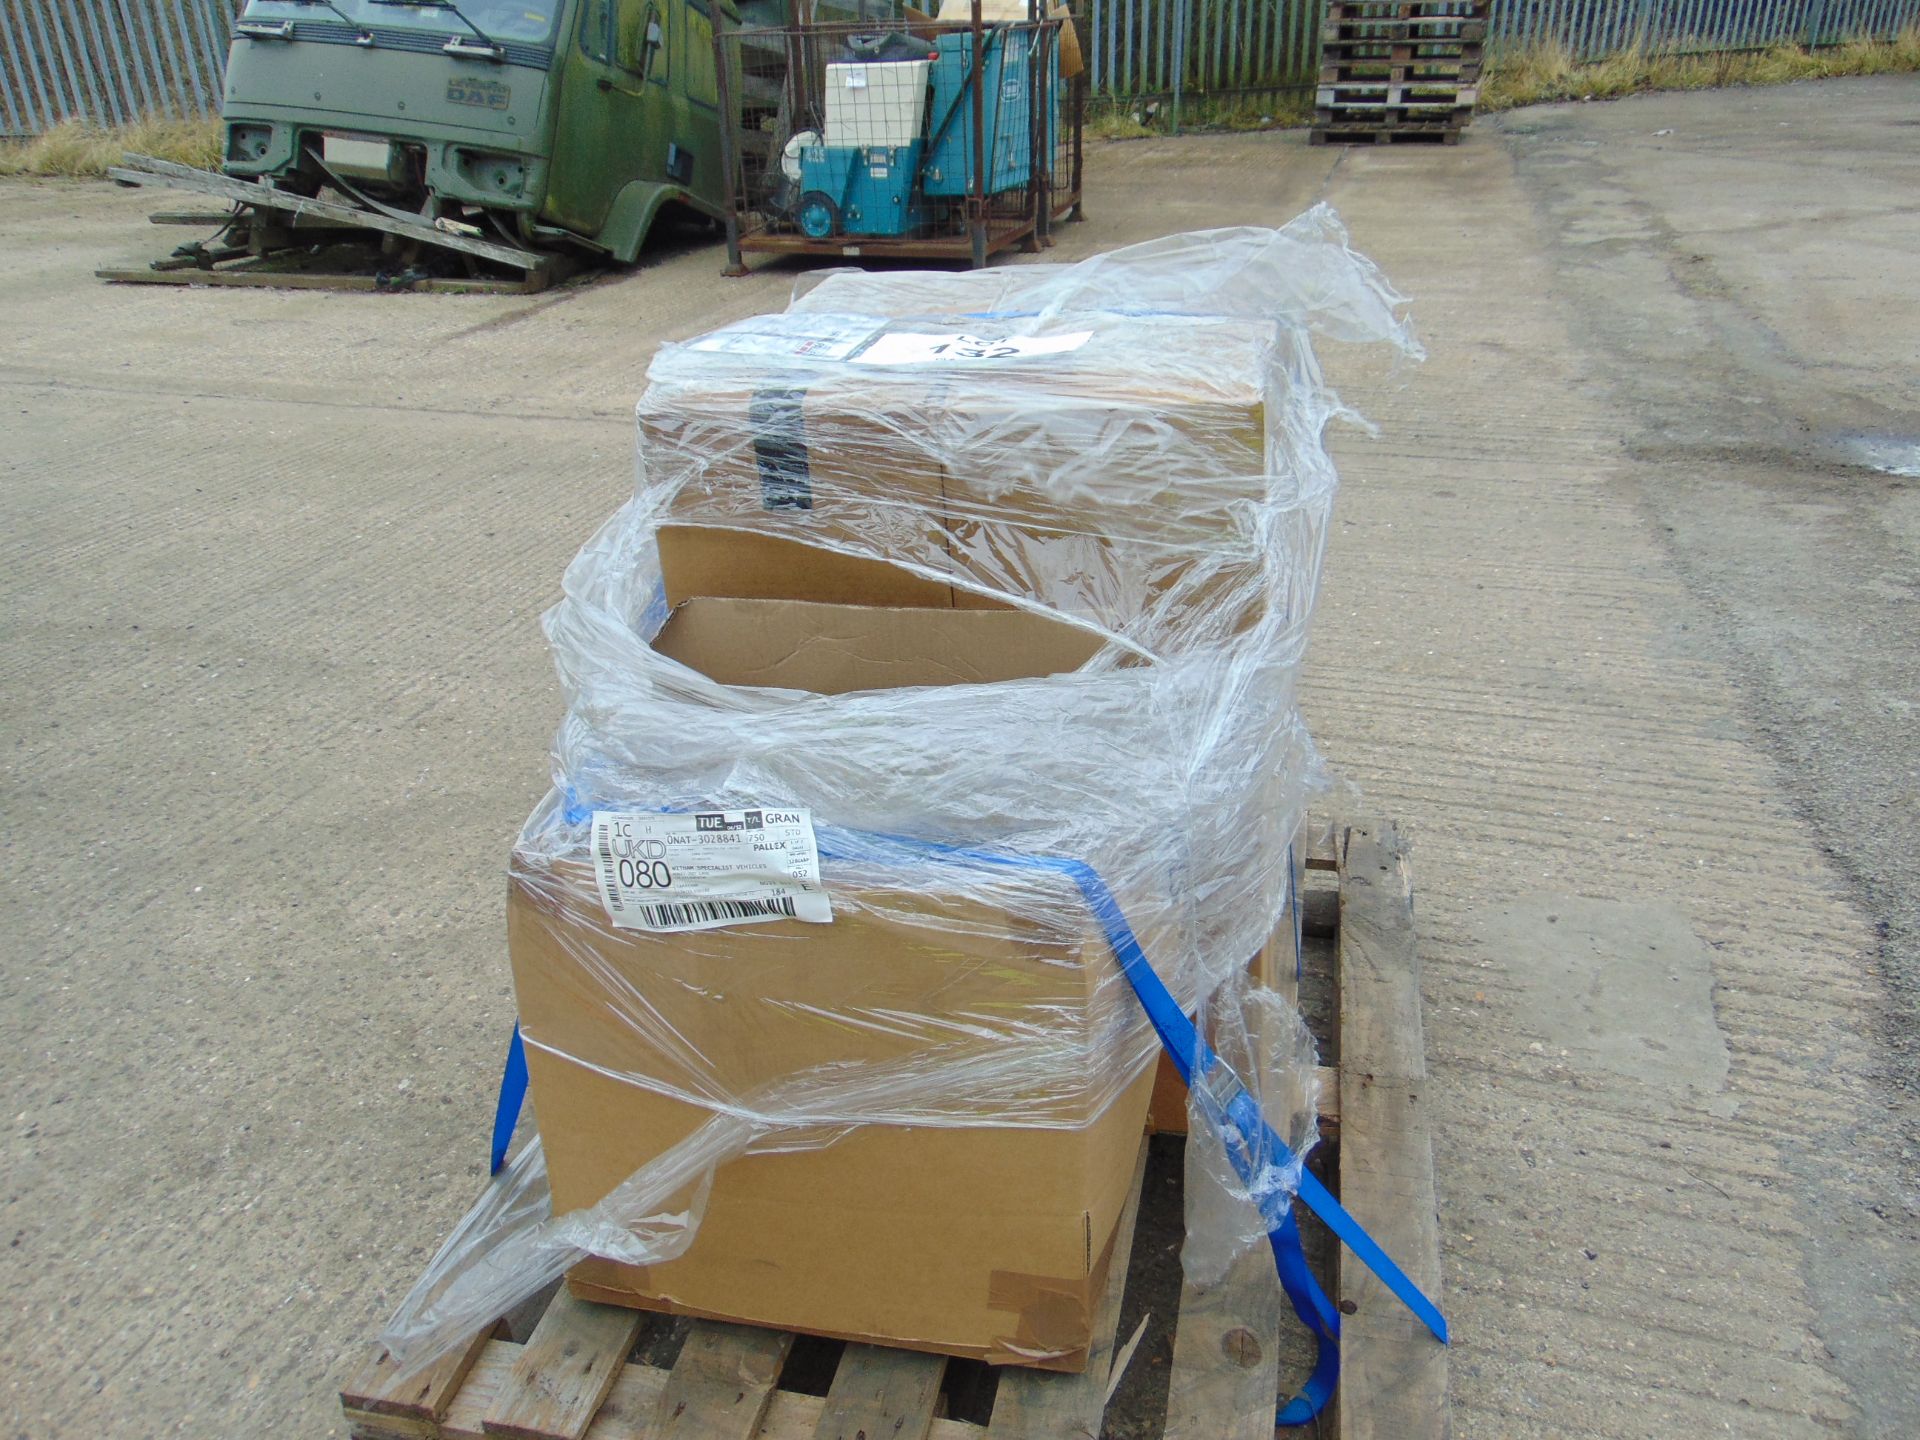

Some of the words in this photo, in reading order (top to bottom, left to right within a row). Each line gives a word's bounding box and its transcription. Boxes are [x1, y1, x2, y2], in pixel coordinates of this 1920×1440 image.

[446, 87, 506, 105] DAF
[929, 344, 1020, 358] 132
[698, 817, 723, 828] TUE
[746, 816, 761, 824] T/L
[765, 813, 800, 824] GRAN
[614, 822, 632, 837] 1C
[748, 834, 765, 842] 750
[612, 838, 666, 860] UKD
[753, 842, 786, 851] PALLEX
[620, 859, 672, 888] 080
[792, 869, 808, 878] 052
[772, 888, 786, 896] 184
